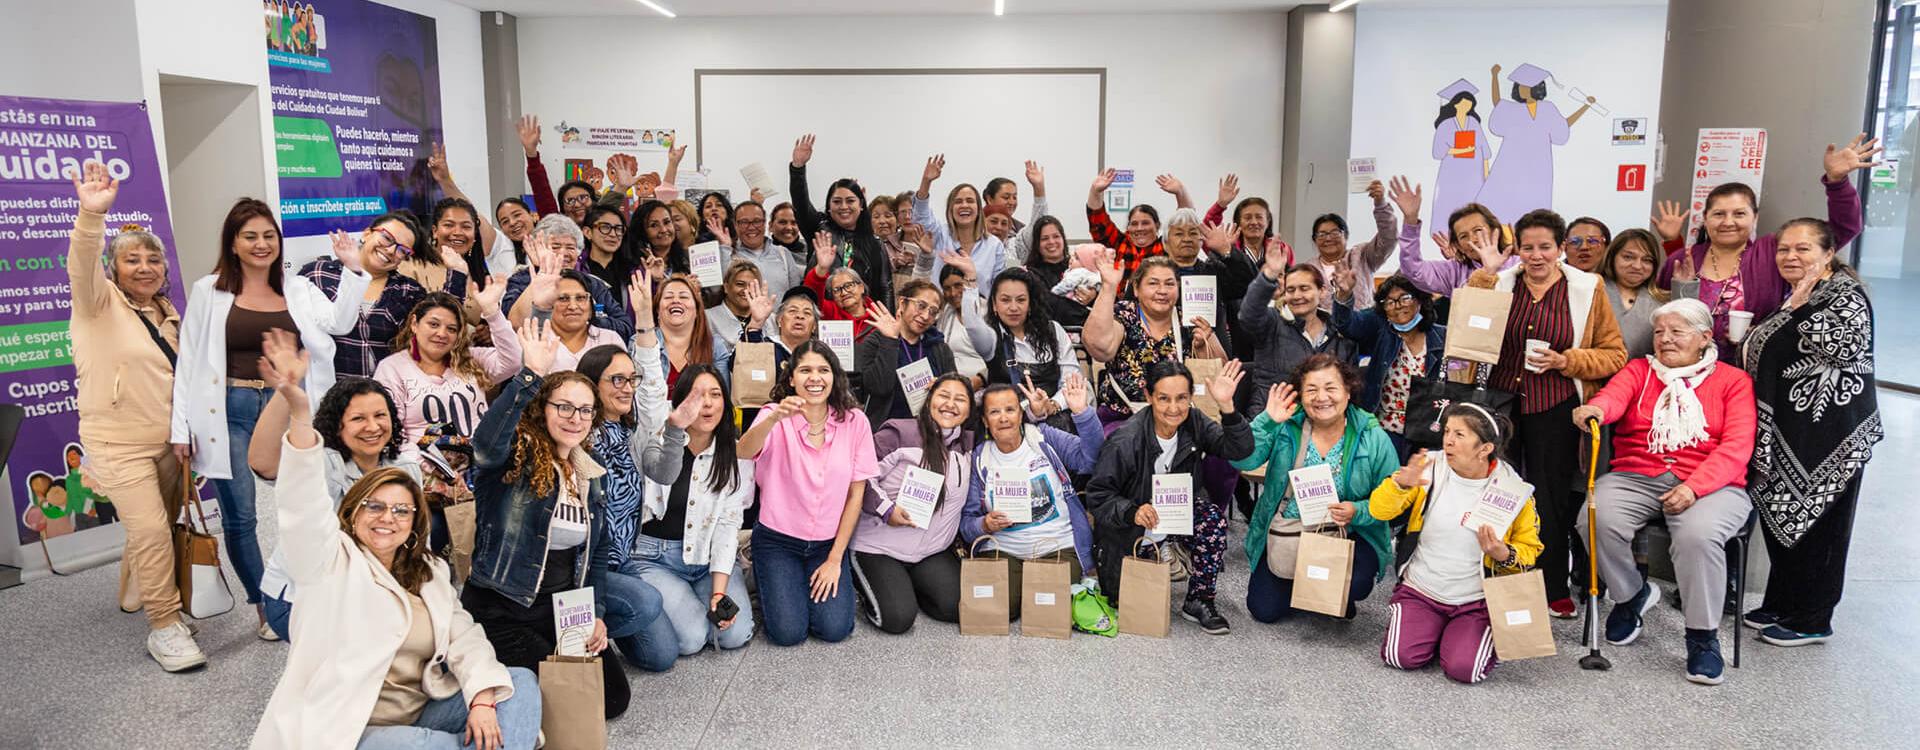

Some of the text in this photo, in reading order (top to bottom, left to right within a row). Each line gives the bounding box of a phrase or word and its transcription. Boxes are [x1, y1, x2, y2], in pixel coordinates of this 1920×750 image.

[271, 85, 297, 95] ervicios
[298, 88, 327, 99] gratuitos
[328, 92, 338, 102] que
[339, 92, 363, 103] tenemos
[364, 96, 375, 106] para
[277, 100, 288, 110] del
[289, 101, 315, 113] Cuidado
[317, 104, 324, 114] de
[325, 104, 346, 116] Ciudad
[0, 109, 96, 127] stás en una
[335, 125, 419, 143] Puedes hacerlo, mientras
[85, 135, 117, 149] DEL
[340, 142, 414, 157] tanto aquí cuidamos a
[0, 148, 130, 181] uidado
[344, 158, 405, 172] quienes tú cuidas.
[1741, 158, 1761, 169] LEE
[1, 197, 80, 210] puedes disfr
[281, 202, 299, 214] ción
[300, 204, 305, 212] e
[306, 200, 343, 213] inscríbete
[344, 200, 364, 214] gratis
[0, 211, 152, 226] cios gratuito estudio,
[23, 228, 71, 239] descans
[16, 257, 53, 270] con
[0, 282, 72, 297] emos servici
[1185, 293, 1214, 301] LA MUJER
[13, 302, 21, 315] y
[24, 301, 54, 313] para
[0, 330, 72, 347] ué espera
[832, 338, 850, 346] MUJER
[0, 350, 50, 366] mpezar
[55, 348, 64, 357] a
[8, 379, 70, 399] Cupos
[905, 383, 914, 392] LA
[16, 395, 79, 418] nscríb
[903, 485, 911, 494] LA
[912, 488, 935, 502] MUJER
[995, 487, 1028, 496] LA MUJER
[1155, 494, 1188, 504] LA MUJER
[1297, 485, 1332, 499] LA MUJER
[1482, 492, 1517, 511] LA MUJER
[560, 612, 592, 628] LA MUJER
